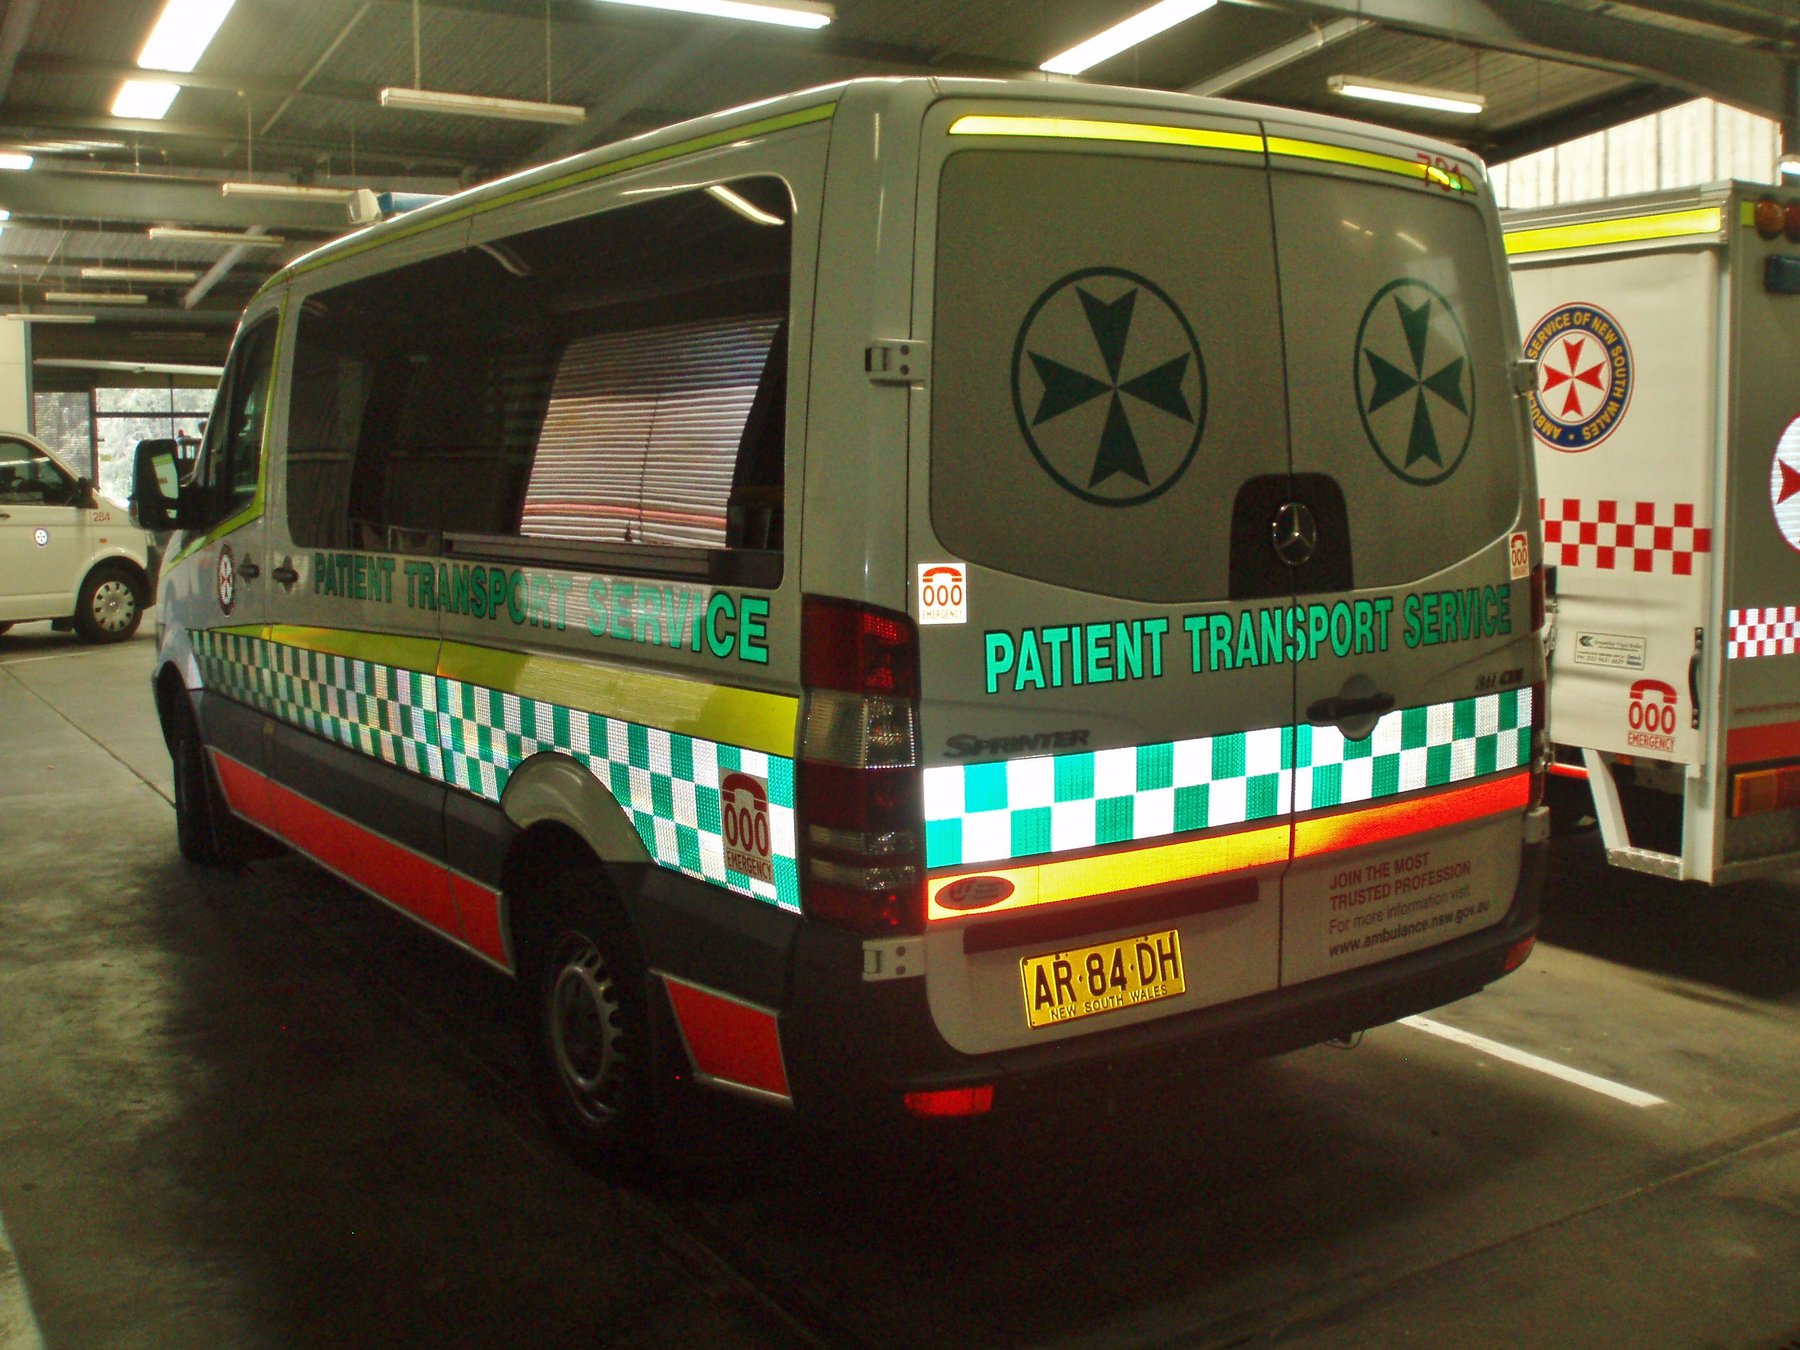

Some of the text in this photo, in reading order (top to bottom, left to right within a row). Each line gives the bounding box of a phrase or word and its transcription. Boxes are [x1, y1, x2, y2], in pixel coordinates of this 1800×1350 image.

[1527, 311, 1627, 440] AMBUL SERVICE OF NEW SOUTH WALES
[93, 512, 111, 521] 284
[1512, 547, 1527, 567] 000
[314, 552, 770, 665] PATIENT TRANSPORT SERVICE
[923, 584, 962, 606] 000
[984, 583, 1511, 694] PATIENT TRANSPORT SERVICE
[1629, 701, 1676, 734] 000
[1628, 731, 1674, 752] EMERGENCY
[724, 802, 768, 857] 000
[727, 850, 772, 880] EMERGENCY
[1329, 852, 1430, 890] JOIN THE MOST
[1330, 861, 1471, 911] TRUSTED PROFESSION
[1329, 917, 1351, 935] For
[1352, 910, 1384, 929] more
[1386, 892, 1448, 917] information
[1329, 900, 1490, 957] www.ambulance.nsw.gov.au
[1050, 985, 1168, 1021] NEW SOUTH WALES
